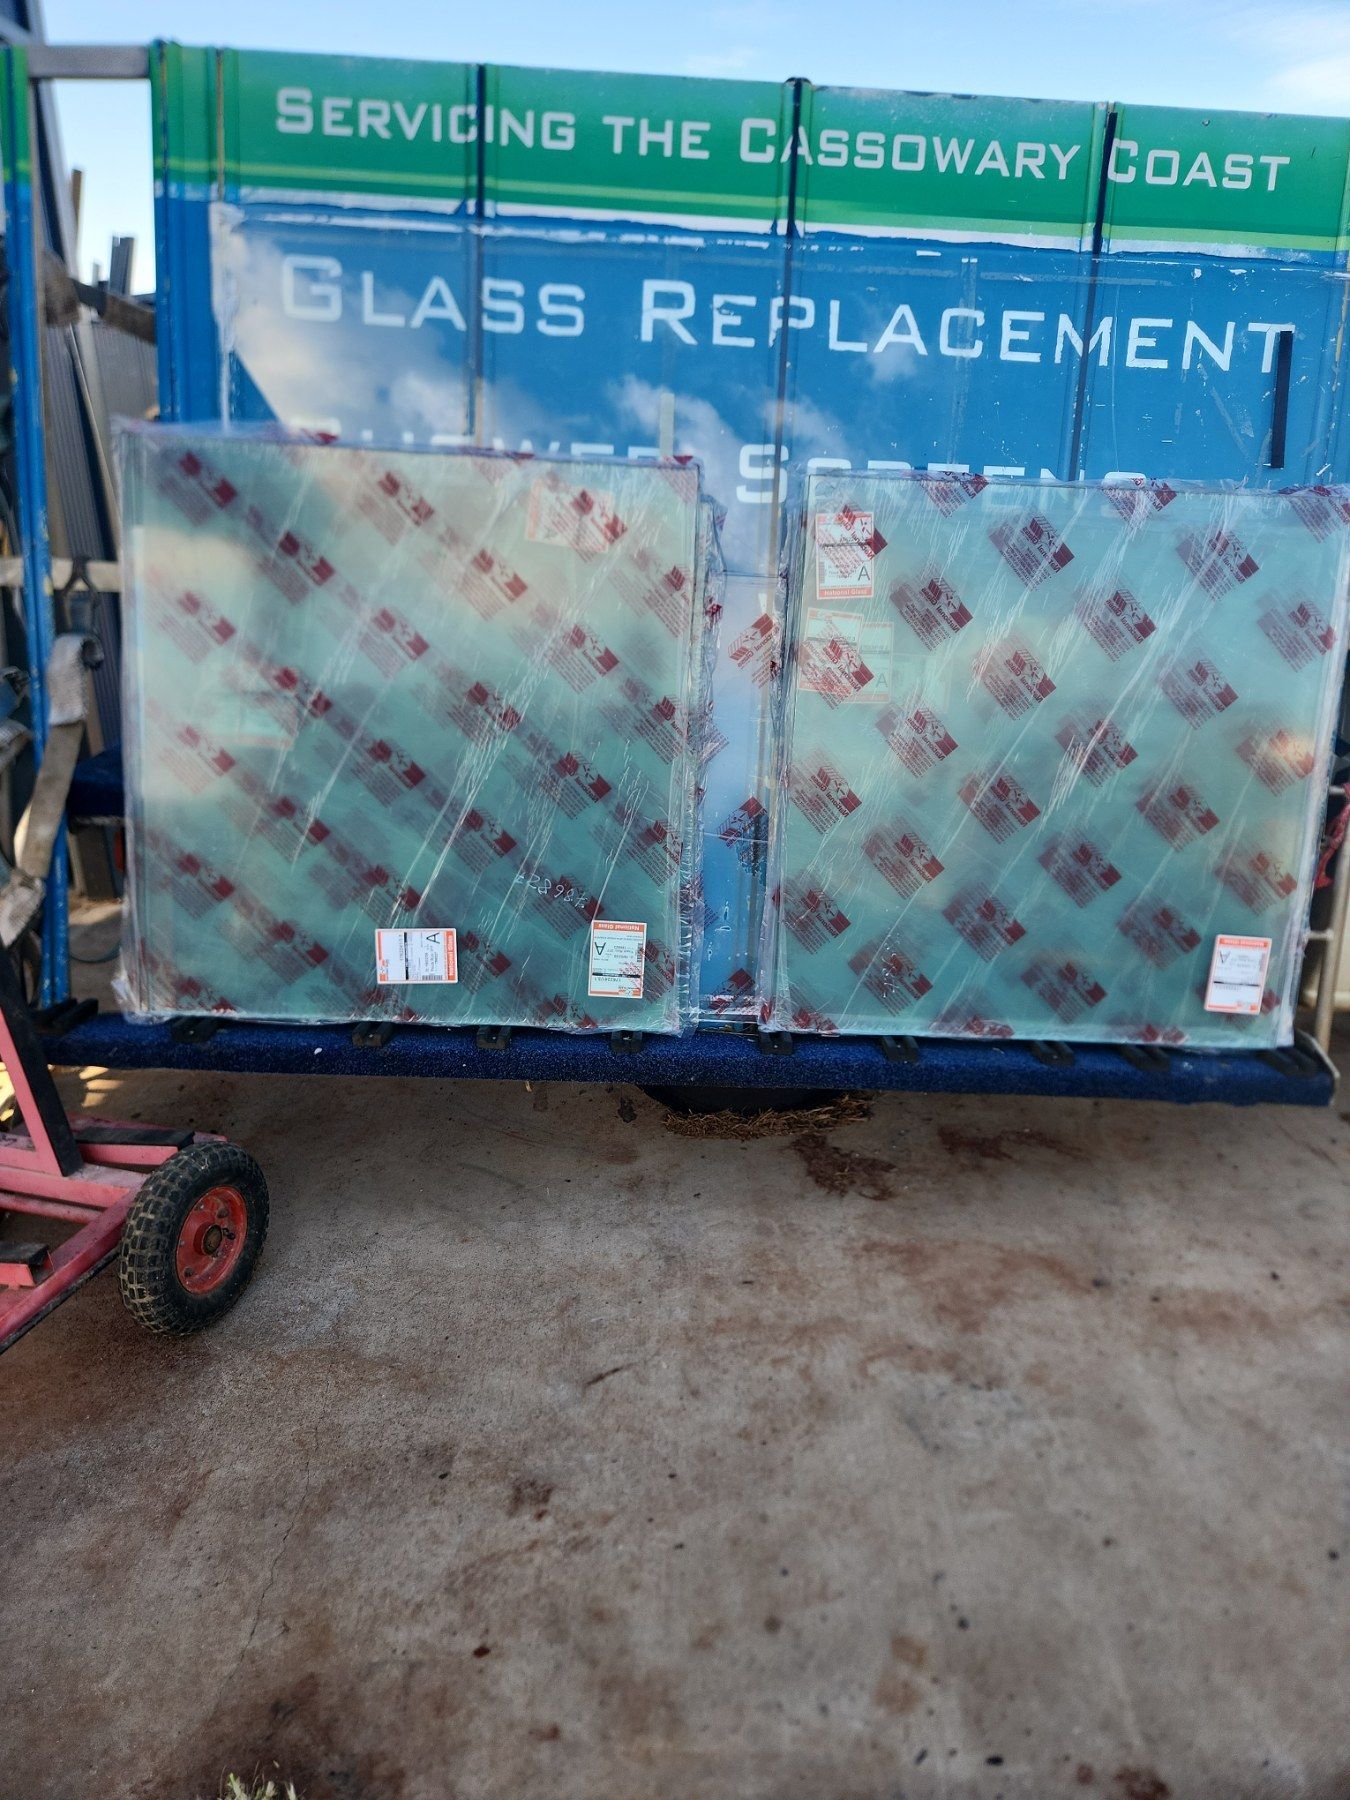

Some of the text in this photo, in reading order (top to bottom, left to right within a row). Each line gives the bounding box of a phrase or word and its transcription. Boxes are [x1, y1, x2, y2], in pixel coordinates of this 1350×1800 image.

[276, 86, 1291, 191] SERVICING THE CASSOWARY COAST
[283, 254, 1296, 374] GLASS REPLACEMENT
[858, 566, 870, 581] A
[426, 932, 441, 945] A
[594, 942, 606, 955] A
